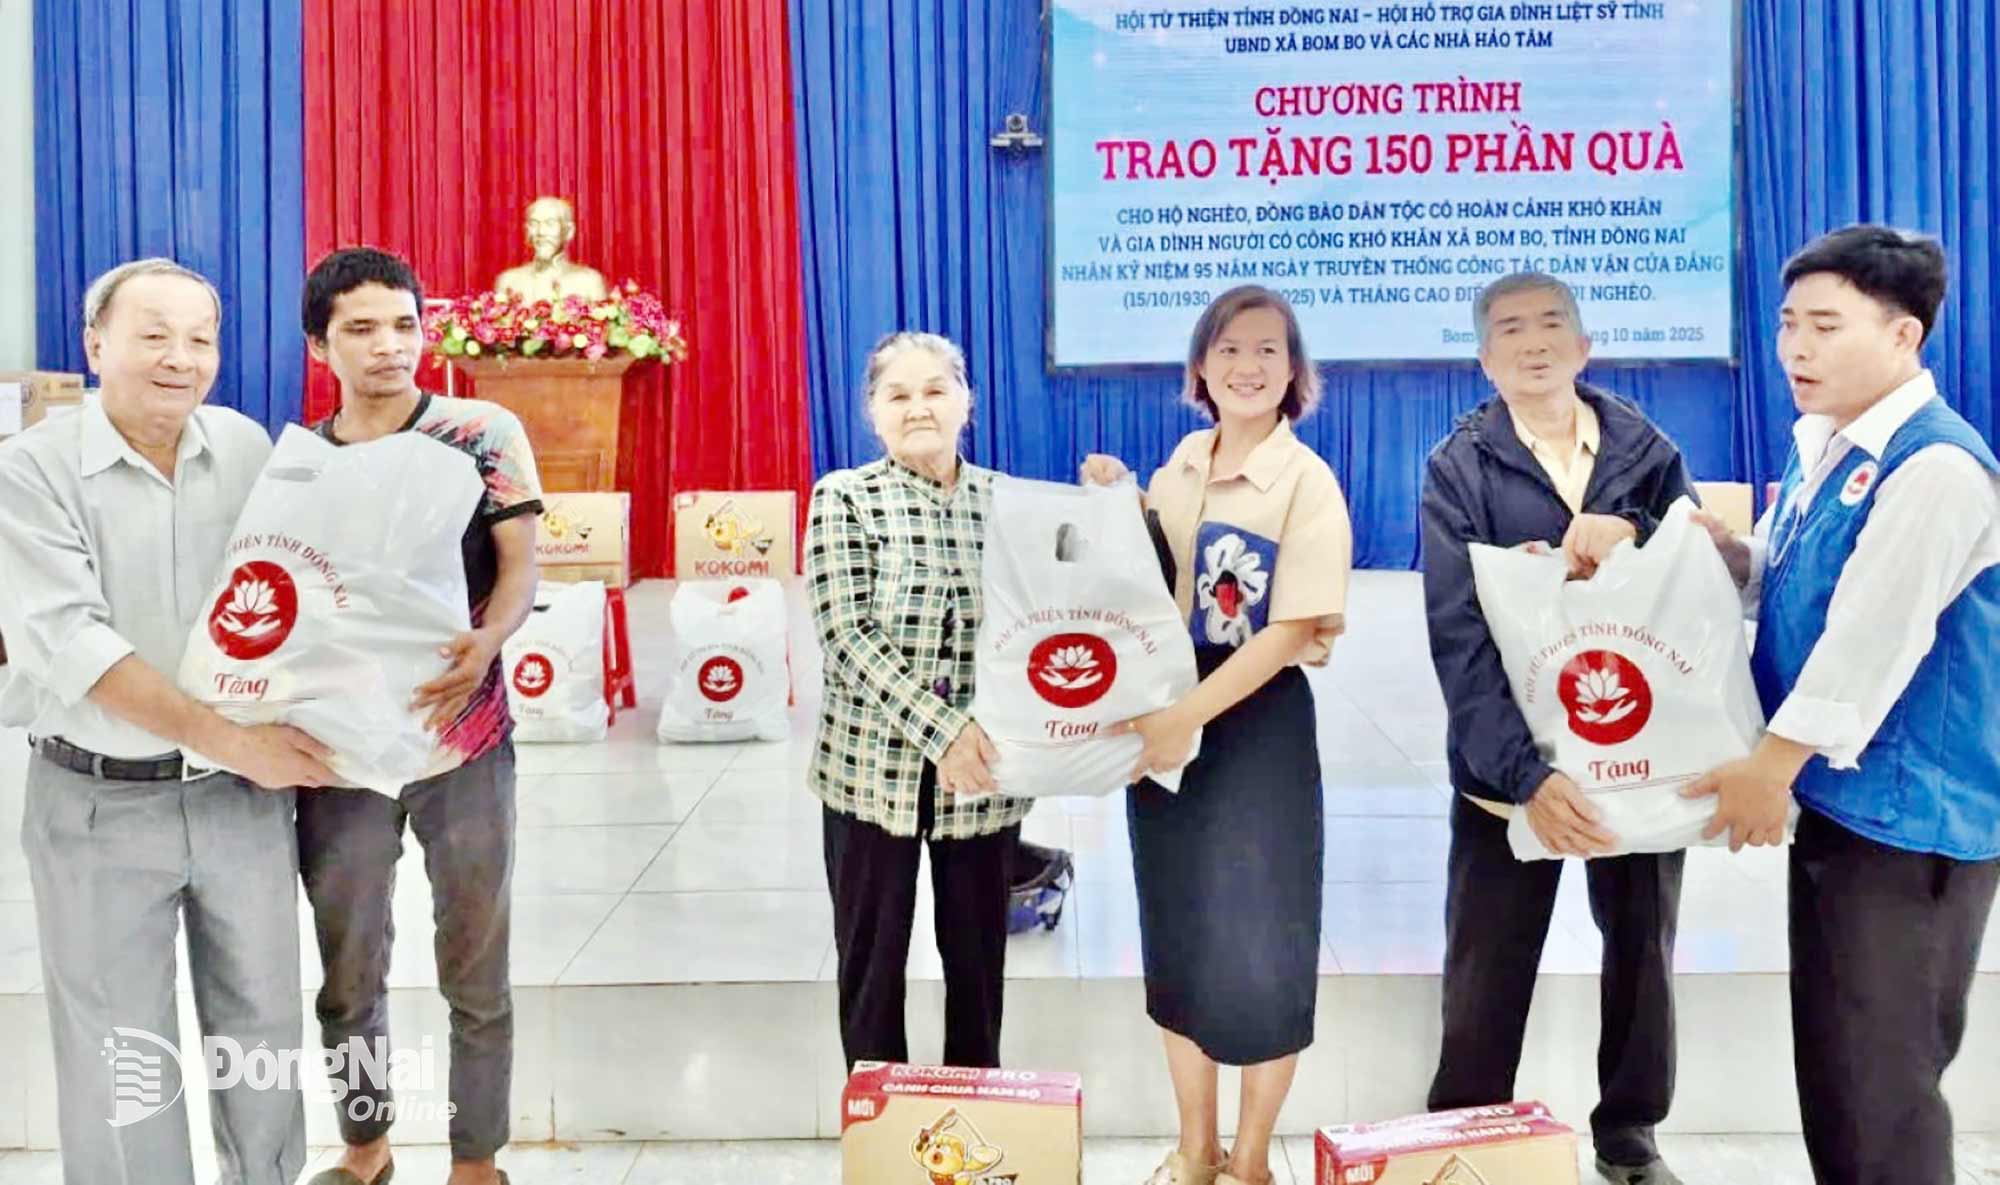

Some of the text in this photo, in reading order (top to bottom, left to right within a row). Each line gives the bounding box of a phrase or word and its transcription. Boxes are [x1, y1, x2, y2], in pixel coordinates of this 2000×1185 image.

[1116, 11, 1145, 32] HỘI
[1177, 9, 1229, 30] THIỆN
[1234, 6, 1275, 27] TỈNH
[1279, 6, 1325, 25] ĐỒNG
[1329, 8, 1359, 24] NAI
[1378, 4, 1408, 24] HỘI
[1440, 5, 1473, 24] TRỢ
[1477, 6, 1506, 21] GIA
[1510, 2, 1552, 21] ĐÌNH
[1556, 2, 1592, 22] LIỆT
[1622, 1, 1664, 20] TỈNH
[1225, 28, 1553, 54] UBND XÃ BOM BO VÀ CÁC NHÀ HẢO TÂM
[1255, 75, 1521, 117] CHƯƠNG TRÌNH
[1096, 121, 1684, 186] TRAO TẶNG 150 PHẦN QUÀ
[1117, 207, 1154, 225] CHO
[1158, 204, 1183, 227] HỘ
[1256, 202, 1304, 222] ĐỒNG
[1348, 200, 1386, 221] DÂN
[1390, 200, 1425, 223] TỘC
[1429, 199, 1453, 219] CÓ
[1457, 199, 1509, 218] HOÀN
[1513, 196, 1563, 217] CẢNH
[1568, 196, 1606, 217] KHÓ
[1099, 233, 1122, 253] VÀ
[1126, 236, 1155, 252] GIA
[1208, 230, 1264, 251] NGƯỜI
[1269, 230, 1292, 250] CÓ
[1296, 230, 1344, 249] CÔNG
[1348, 229, 1387, 249] KHÓ
[1446, 227, 1470, 247] XÃ
[1476, 229, 1515, 246] BOM
[1551, 225, 1596, 246] TỈNH
[1601, 225, 1650, 245] ĐỒNG
[1655, 227, 1687, 244] NAI
[1062, 261, 1112, 281] NHÂN
[1145, 260, 1189, 284] NIỆM
[1194, 263, 1213, 279] 95
[1217, 259, 1257, 278] NĂM
[1262, 257, 1309, 277] NGÀY
[1313, 255, 1386, 277] TRUYỀN
[1390, 254, 1453, 276] THỐNG
[1457, 254, 1505, 275] CÔNG
[1510, 254, 1545, 274] TÁC
[1549, 254, 1588, 274] DÂN
[1592, 253, 1630, 276] VẬN
[1634, 252, 1670, 273] CỦA
[1675, 251, 1725, 273] ĐẢNG
[1319, 284, 1345, 305] VÀ
[1349, 282, 1411, 305] THÁNG
[1414, 286, 1451, 303] CAO
[1614, 327, 1629, 342] 10
[1669, 326, 1705, 342] 2025
[694, 559, 769, 577] KOKOMI
[1588, 757, 1651, 783] Tặng
[986, 1069, 1038, 1082] PRO
